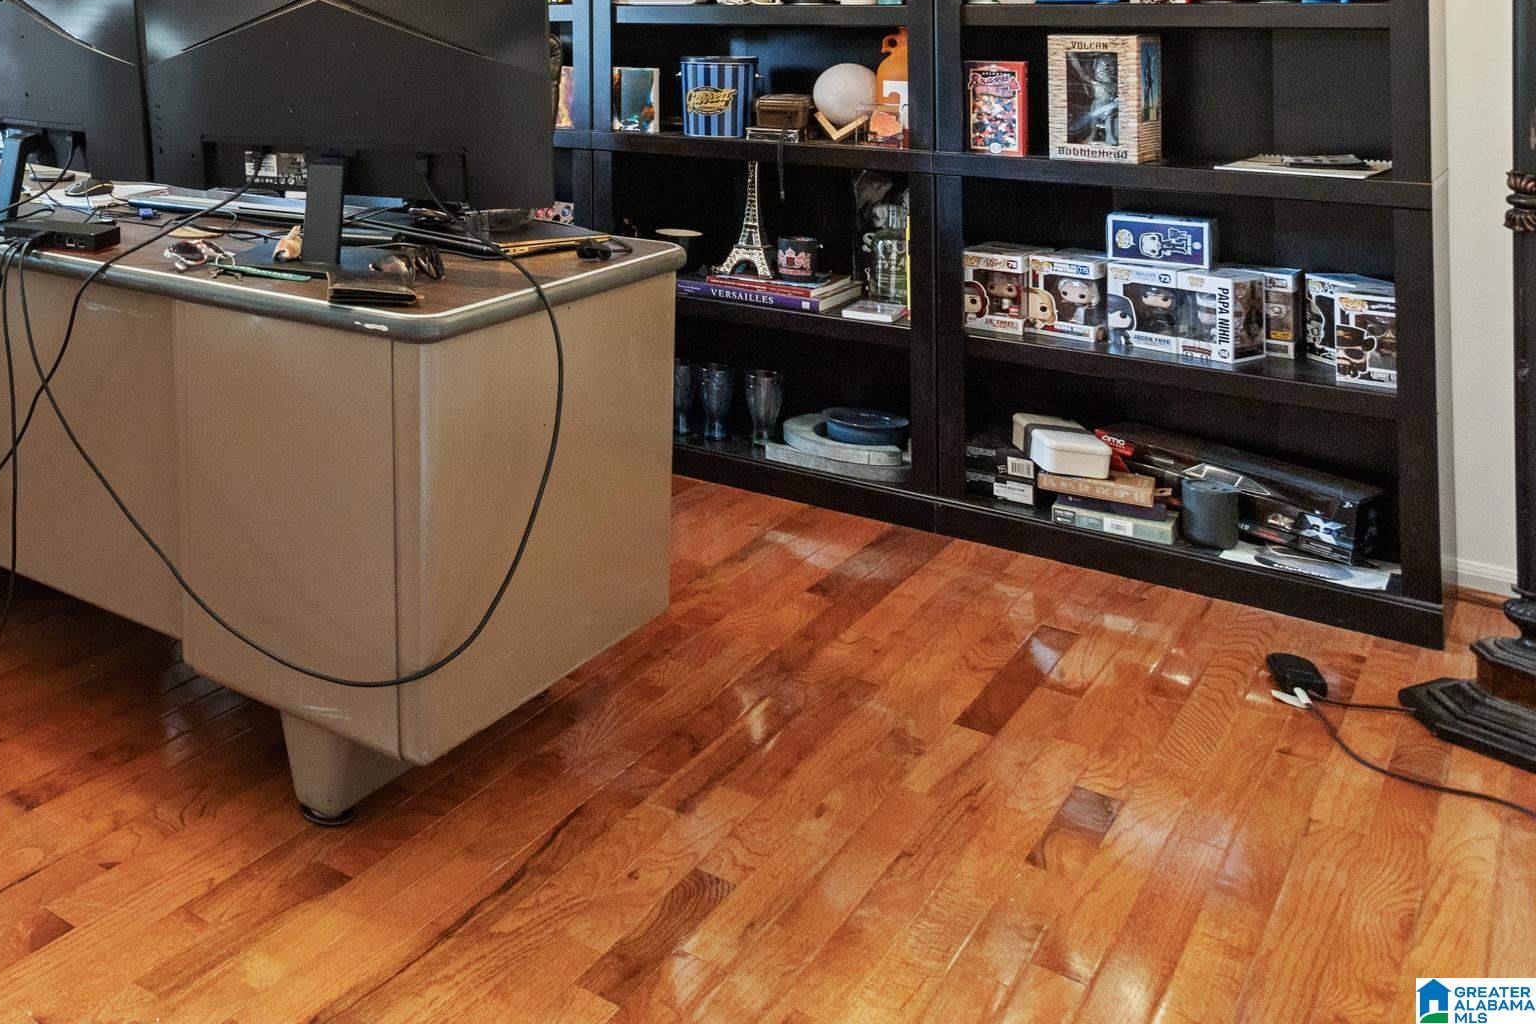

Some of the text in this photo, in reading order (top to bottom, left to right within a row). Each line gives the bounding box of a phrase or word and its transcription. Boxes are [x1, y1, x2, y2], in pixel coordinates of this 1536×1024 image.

[711, 288, 774, 305] VERSAILLES
[1218, 287, 1230, 345] PAPA NIHIL
